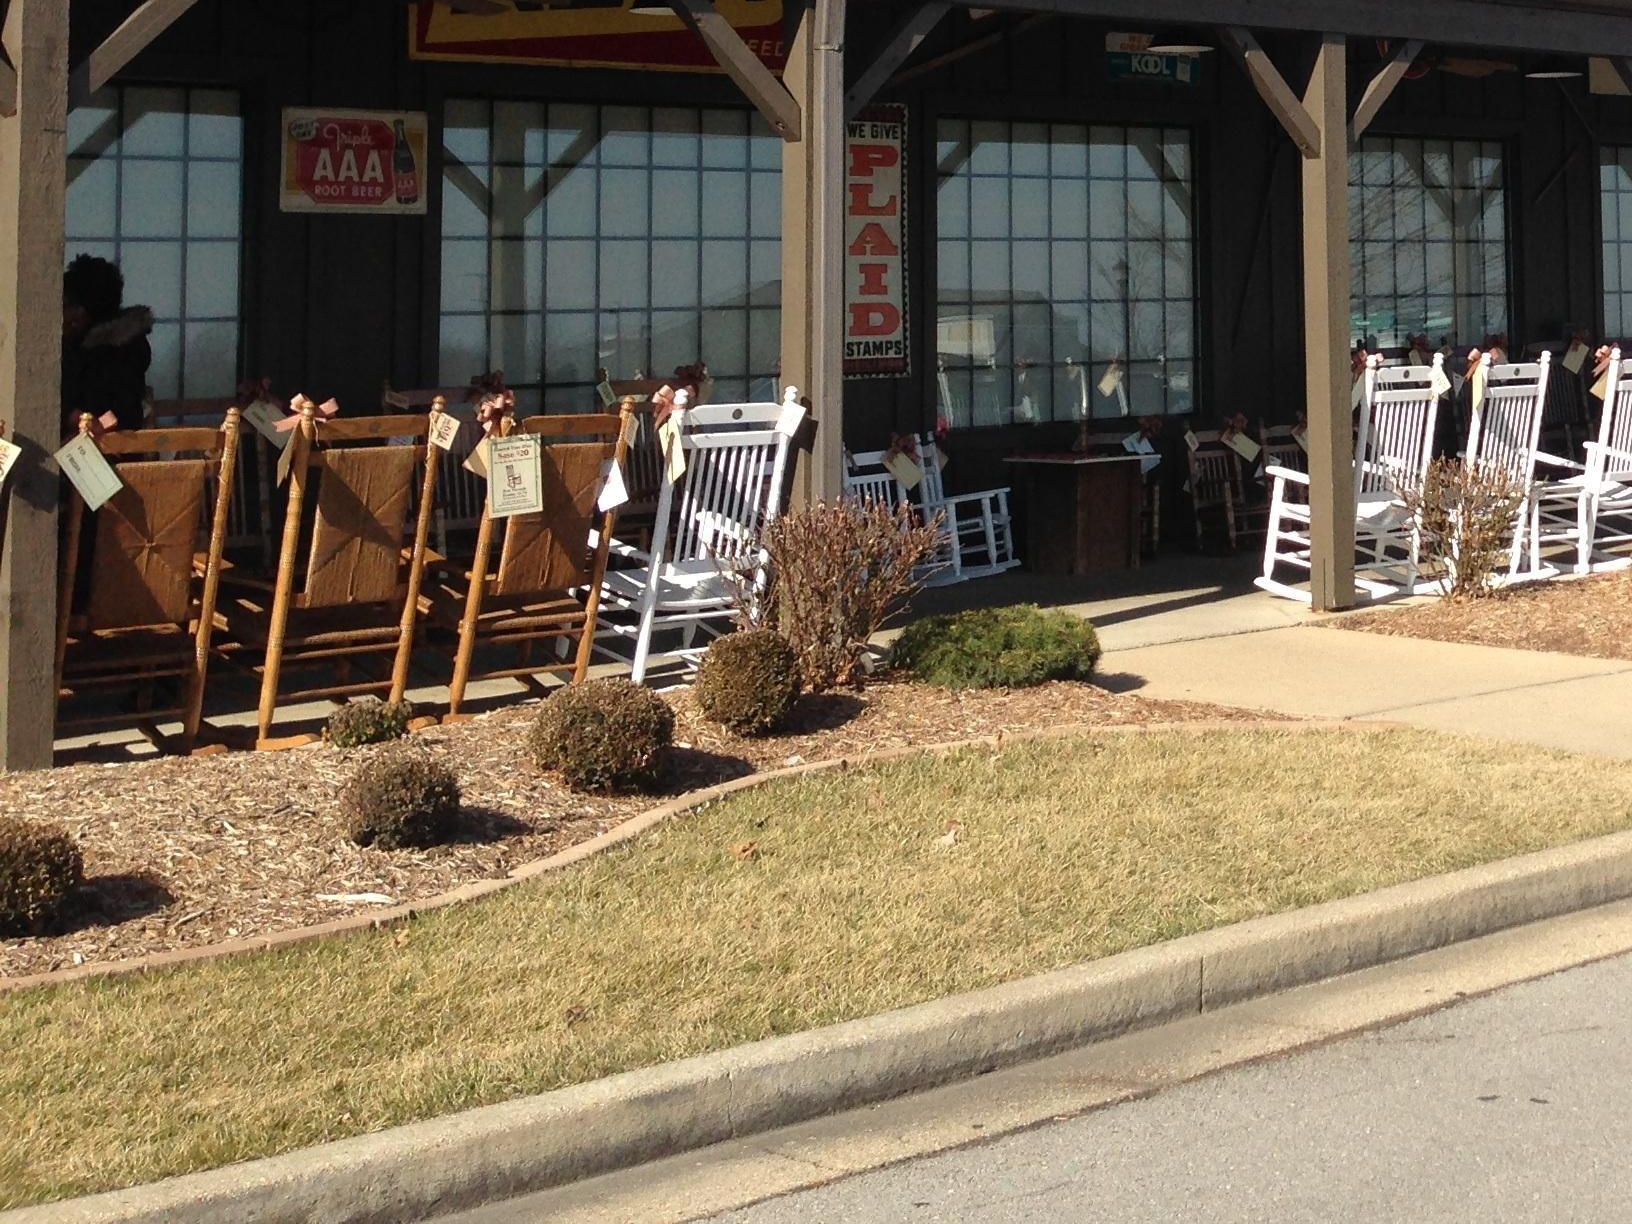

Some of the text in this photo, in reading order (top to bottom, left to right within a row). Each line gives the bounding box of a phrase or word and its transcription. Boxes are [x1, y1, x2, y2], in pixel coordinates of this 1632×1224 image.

[1131, 54, 1170, 74] KOOL
[323, 123, 376, 151] Triple
[847, 124, 899, 139] WE GIVE
[312, 147, 385, 183] AAA
[315, 184, 383, 197] ROOT BEER
[848, 143, 903, 337] PLAID
[846, 340, 903, 358] STAMPS
